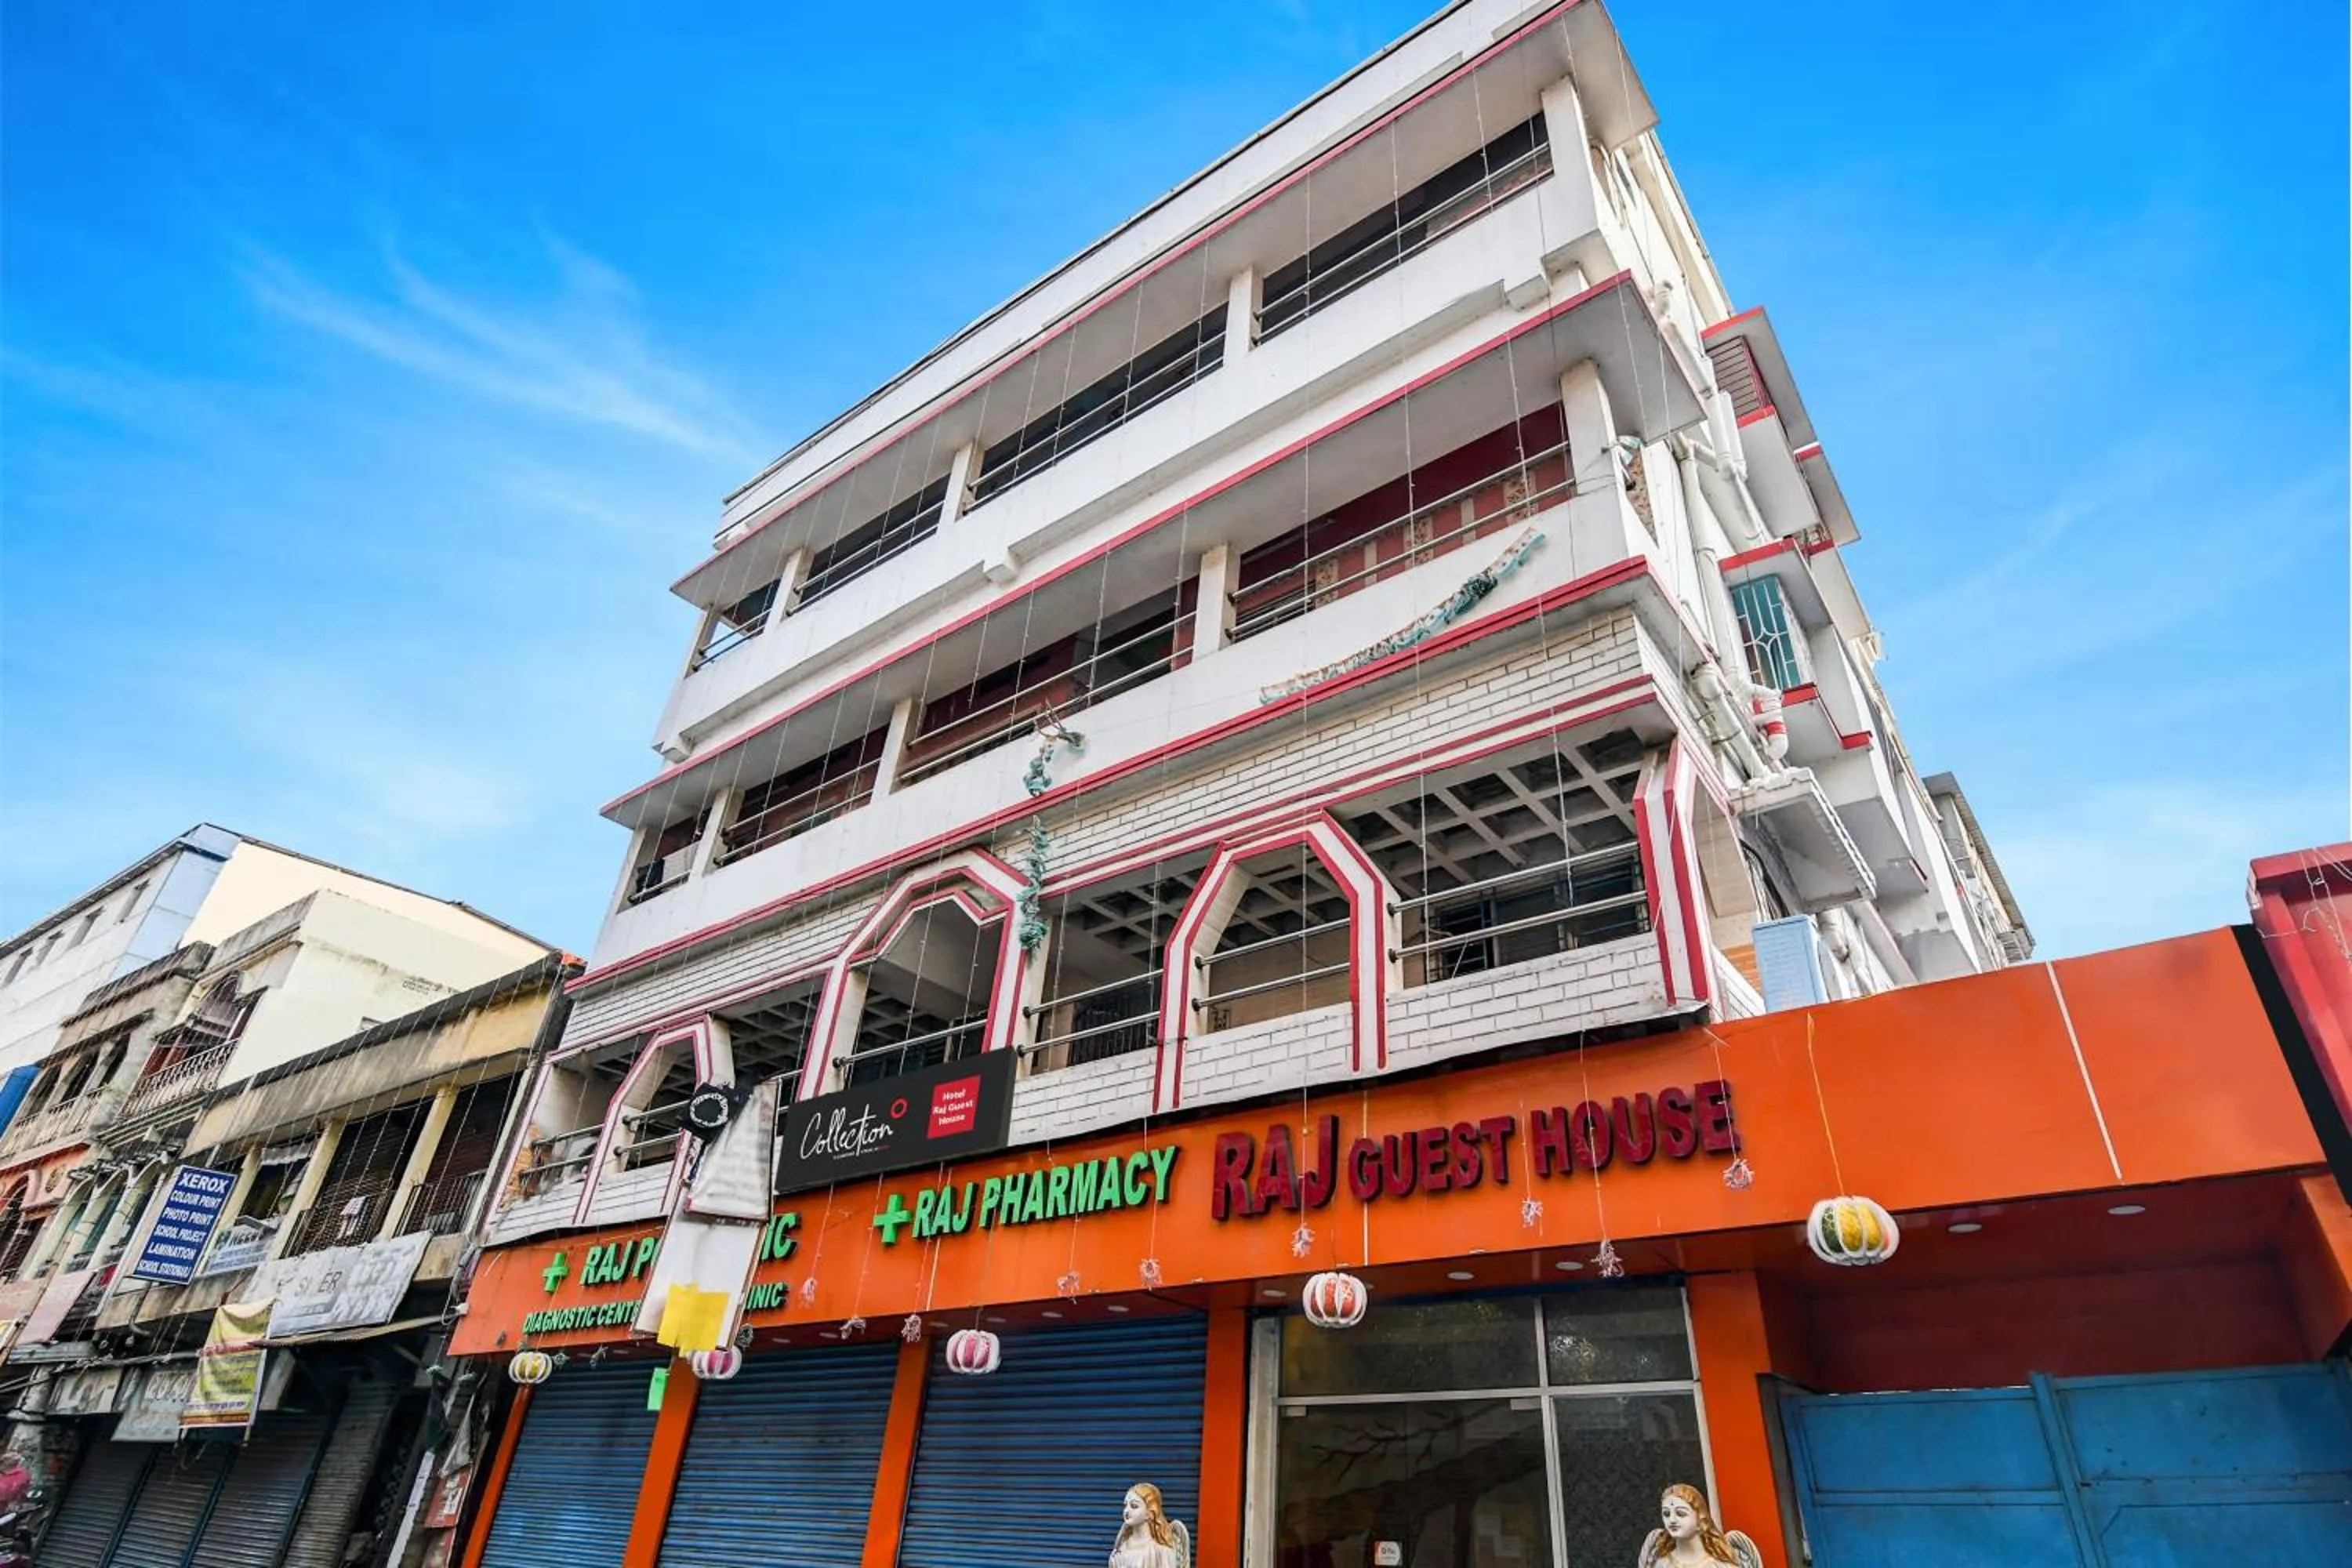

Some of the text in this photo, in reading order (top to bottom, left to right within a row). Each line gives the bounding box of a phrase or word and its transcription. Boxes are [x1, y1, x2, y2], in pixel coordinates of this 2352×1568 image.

[800, 1104, 893, 1160] Collection
[1212, 1079, 1740, 1219] RAJ GUEST HOUSE
[178, 1172, 229, 1194] XEROX
[911, 1145, 1176, 1238] RAJ PHARMACY
[170, 1190, 222, 1208] COLOUR PRINT
[162, 1207, 214, 1225] PHOTO PRINT
[147, 1242, 197, 1259] LAMINATION
[579, 1240, 633, 1285] RAJ
[523, 1305, 597, 1334] DIAGNOSTIC
